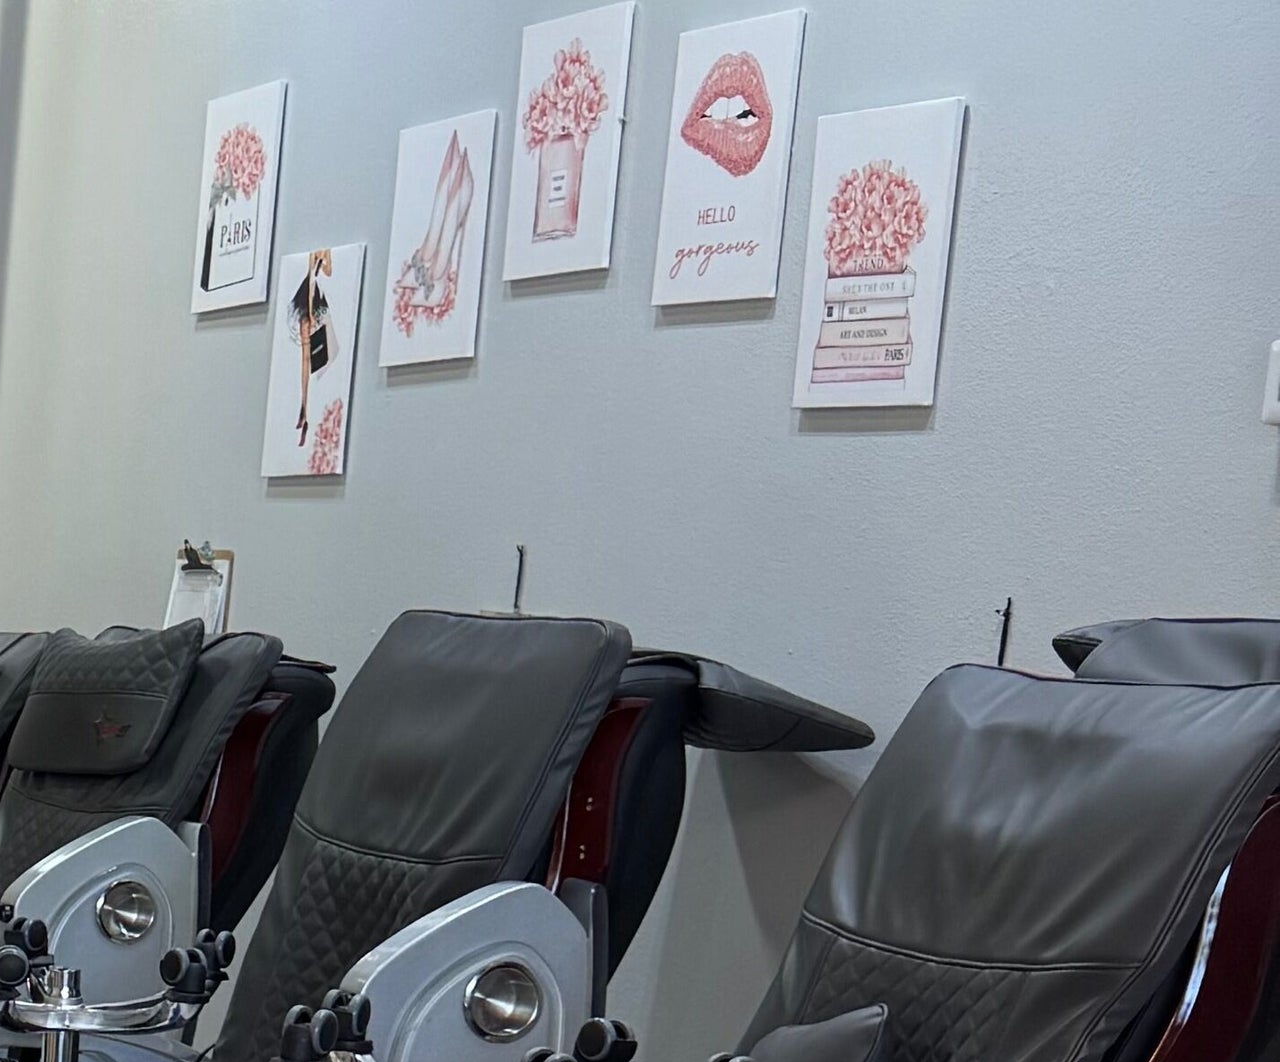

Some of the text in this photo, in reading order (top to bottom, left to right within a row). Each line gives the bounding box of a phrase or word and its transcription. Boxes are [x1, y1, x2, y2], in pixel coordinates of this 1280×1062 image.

[697, 205, 736, 226] HELLO
[220, 218, 252, 248] PARIS
[669, 240, 760, 279] gorgeous
